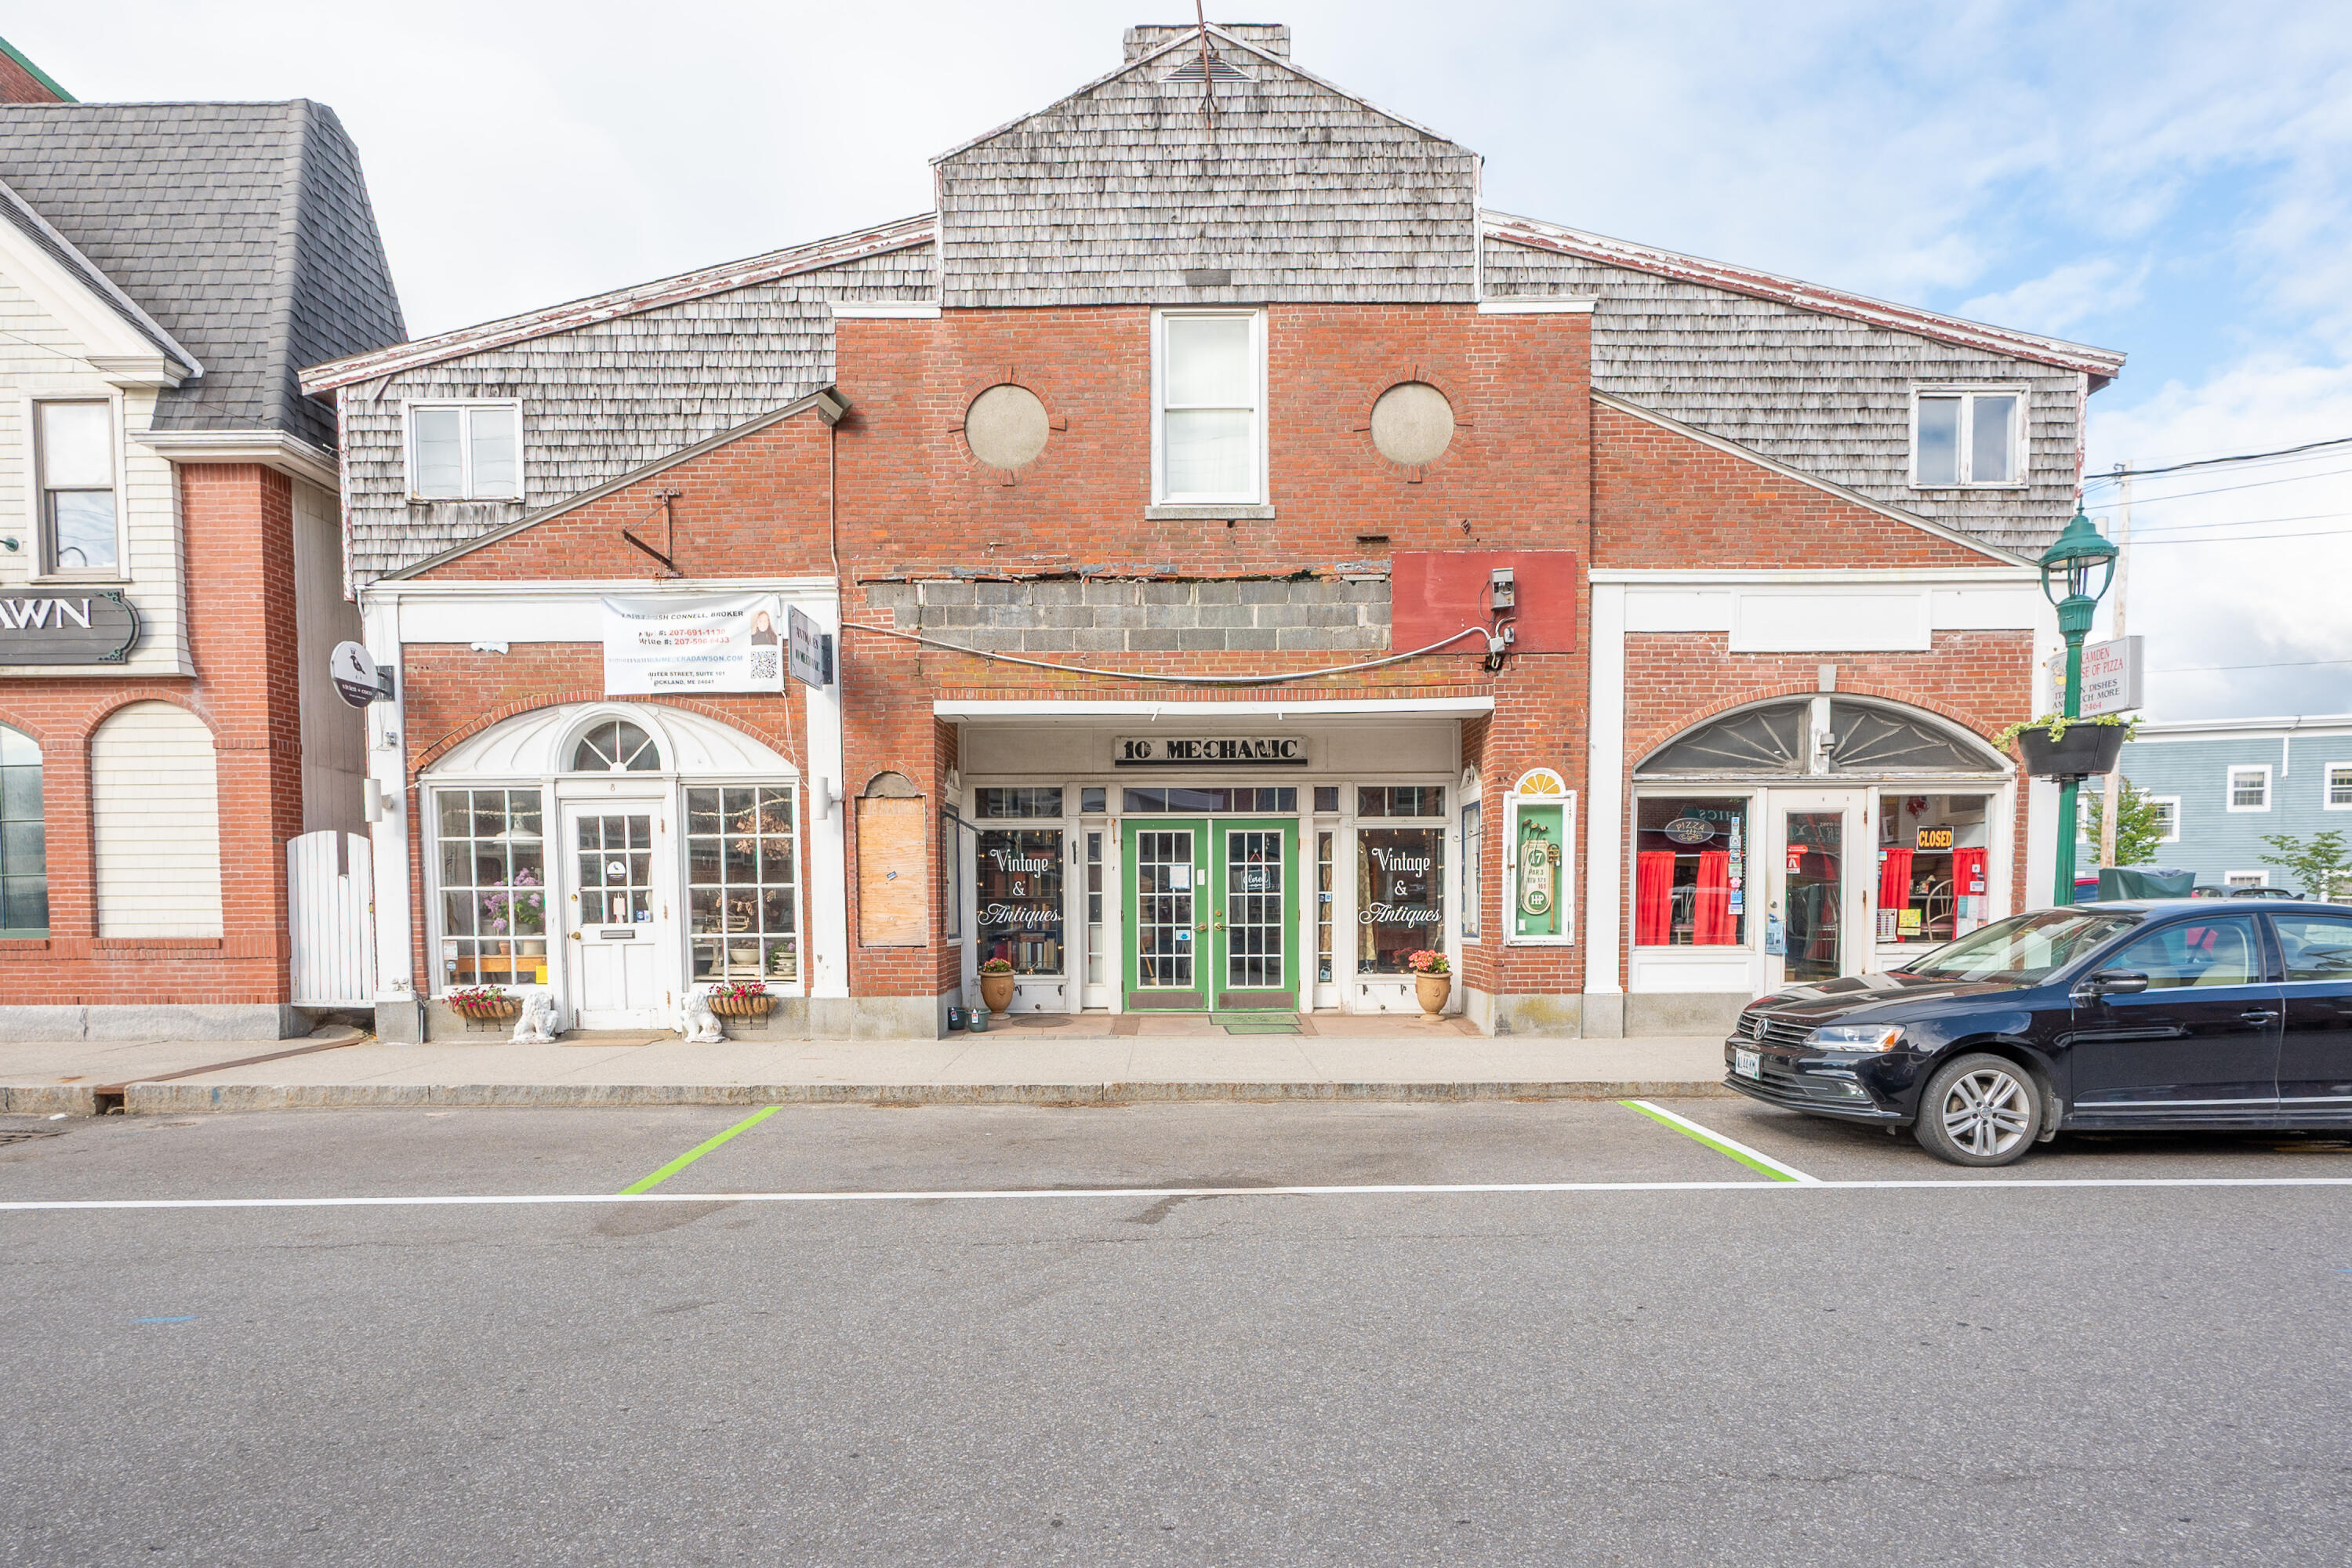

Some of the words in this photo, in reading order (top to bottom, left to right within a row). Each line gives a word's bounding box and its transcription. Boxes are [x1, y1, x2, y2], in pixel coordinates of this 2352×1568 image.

[2103, 658, 2124, 674] PIZZA
[2089, 678, 2118, 692] DISHES
[2096, 688, 2121, 700] MORE
[1124, 740, 1152, 759] 10
[1167, 739, 1298, 759] MECHANIC
[1918, 830, 1953, 848] CLOSED
[989, 849, 1049, 878] Vintage
[1371, 848, 1430, 878] Vintage
[1012, 881, 1026, 896] &
[1394, 880, 1408, 896] &
[978, 903, 1058, 929] Antiques
[1359, 902, 1443, 929] Antiques
